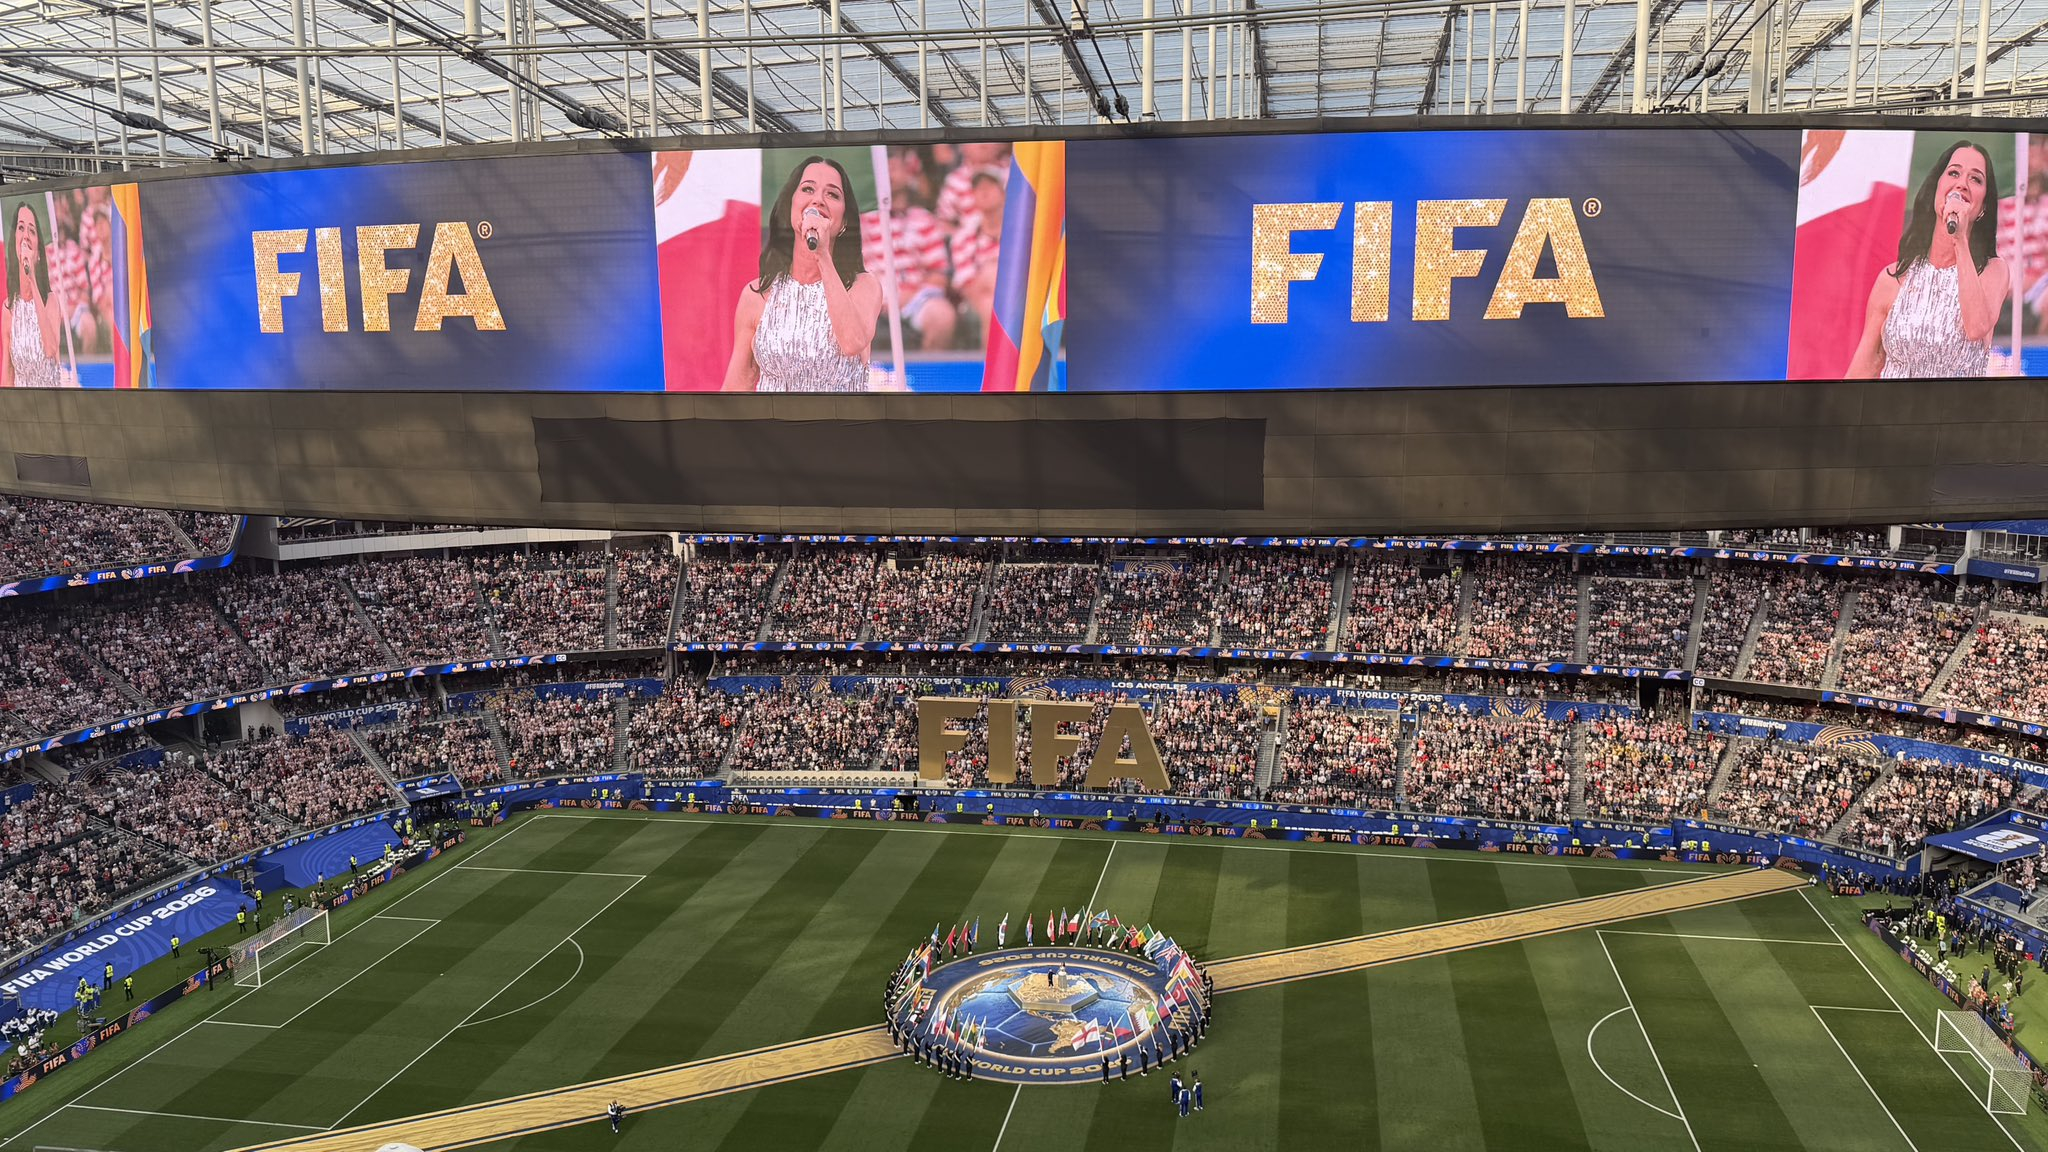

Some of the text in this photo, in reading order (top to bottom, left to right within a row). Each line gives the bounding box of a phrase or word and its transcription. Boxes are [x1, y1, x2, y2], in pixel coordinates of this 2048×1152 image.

[148, 565, 167, 574] FIFA
[98, 572, 116, 580] FIFA
[1136, 682, 1188, 690] ANGELES
[1337, 690, 1356, 698] FIFA
[1357, 690, 1390, 700] WORLD
[1410, 694, 1444, 702] 2026
[1858, 698, 1874, 706] FIFA
[320, 710, 354, 722] WORLD
[356, 706, 374, 717] CUP
[375, 701, 408, 714] 2026
[1902, 704, 1918, 712] FIFA
[147, 714, 161, 722] FIFA
[111, 722, 124, 731] FIFA
[2002, 720, 2018, 730] FIFA
[918, 696, 1171, 791] FIFA
[26, 744, 40, 753] FIFA
[1980, 754, 2010, 766] LOS
[1166, 825, 1184, 833] FIFA
[1216, 828, 1236, 836] FIFA
[1332, 834, 1351, 842] FIFA
[1385, 836, 1406, 845] FIFA
[444, 837, 456, 850] FIFA
[1506, 844, 1527, 852] FIFA
[1563, 846, 1584, 855] FIFA
[1844, 850, 1858, 858] FIFA
[1689, 853, 1710, 862] FIFA
[1878, 859, 1891, 867] FIFA
[371, 874, 384, 888] FIFA
[1840, 886, 1860, 895] FIFA
[333, 894, 348, 906] FIFA
[0, 886, 216, 994] FIFA WORLD CUP 2026
[978, 952, 1034, 966] 2026
[1070, 953, 1124, 968] WORLD
[1126, 963, 1156, 977] FIFA
[1914, 958, 1926, 975] FIFA
[206, 963, 223, 980] FFA
[1946, 986, 1959, 1003] FIFA
[100, 1022, 120, 1040] FIFA
[44, 1054, 66, 1073] FIFA
[1029, 1068, 1066, 1076] CUP
